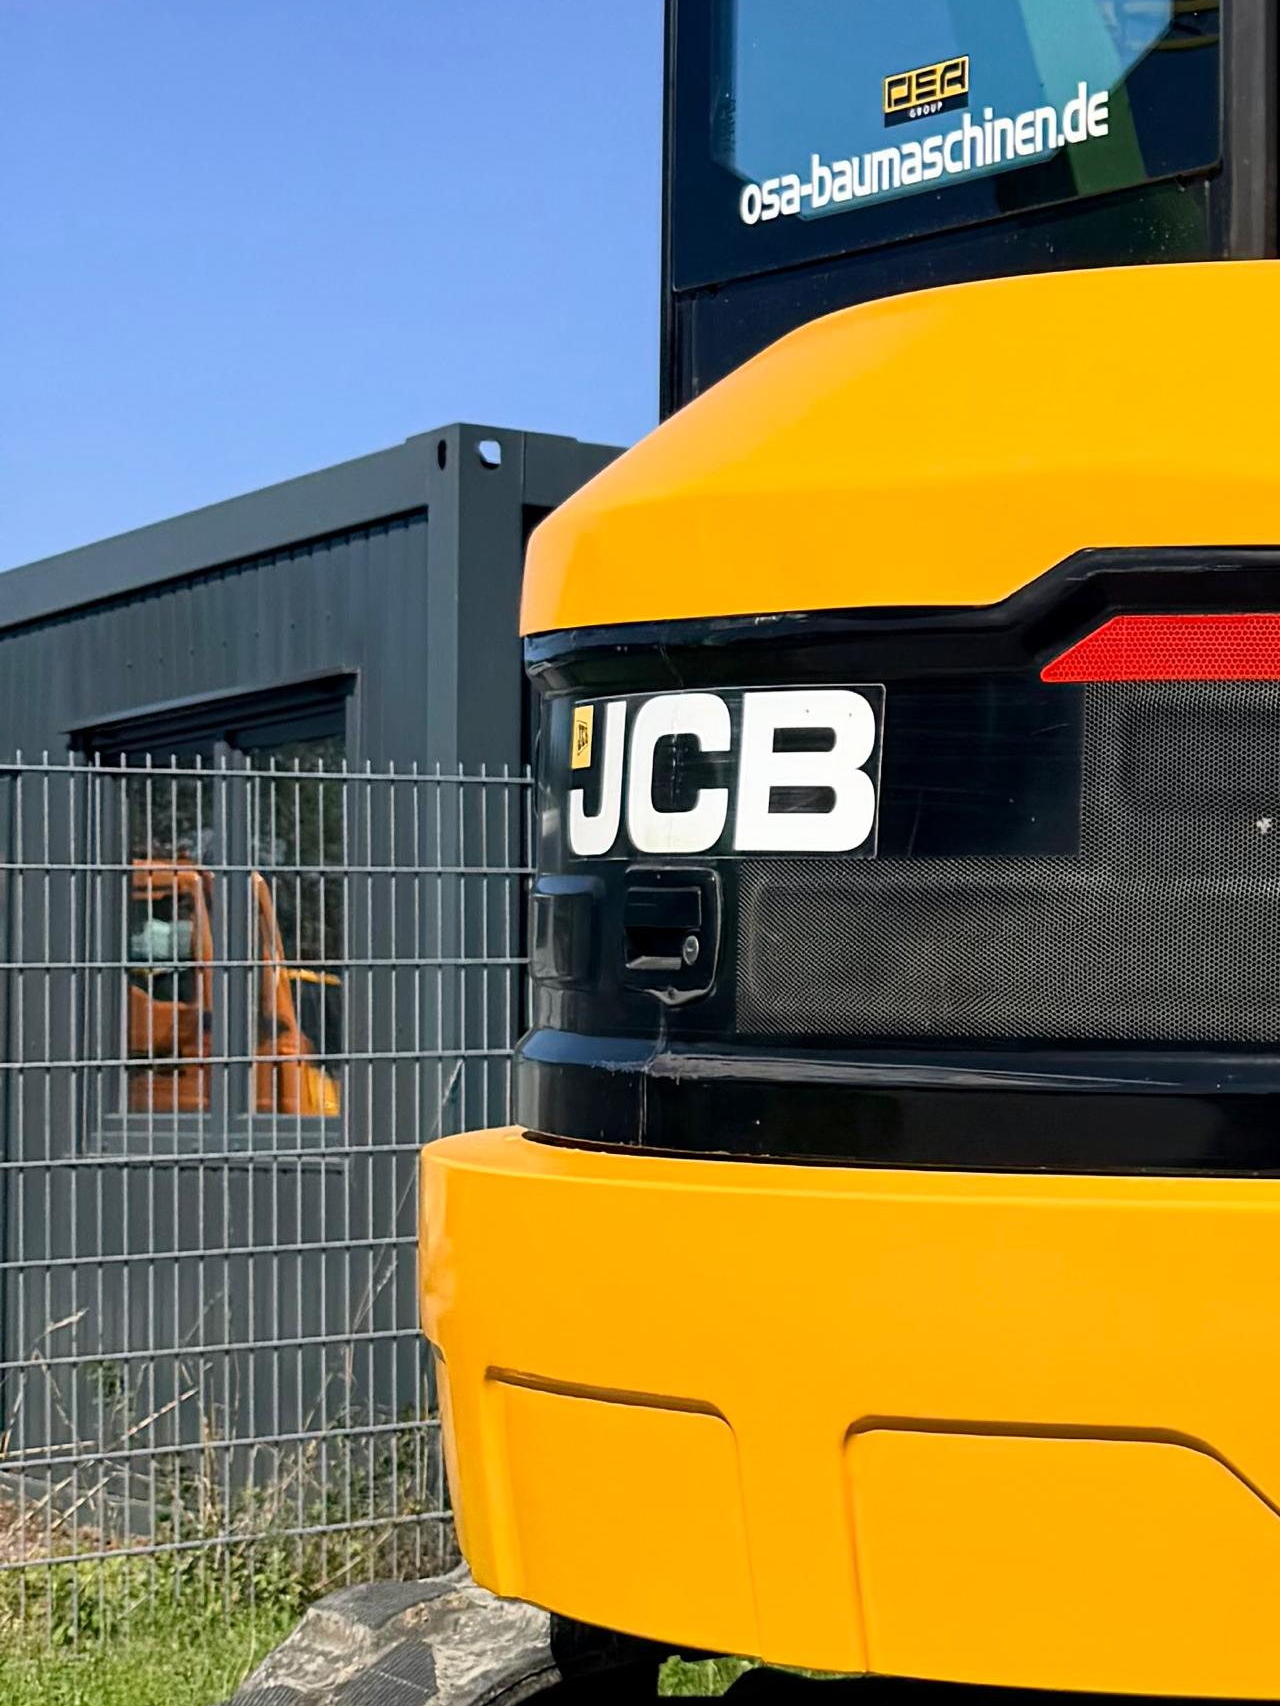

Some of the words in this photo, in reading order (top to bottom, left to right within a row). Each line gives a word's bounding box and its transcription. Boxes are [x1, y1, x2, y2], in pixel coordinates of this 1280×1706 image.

[740, 81, 1110, 225] osa-baumaschinen.de
[908, 100, 943, 119] GROUP
[569, 689, 876, 856] JCB
